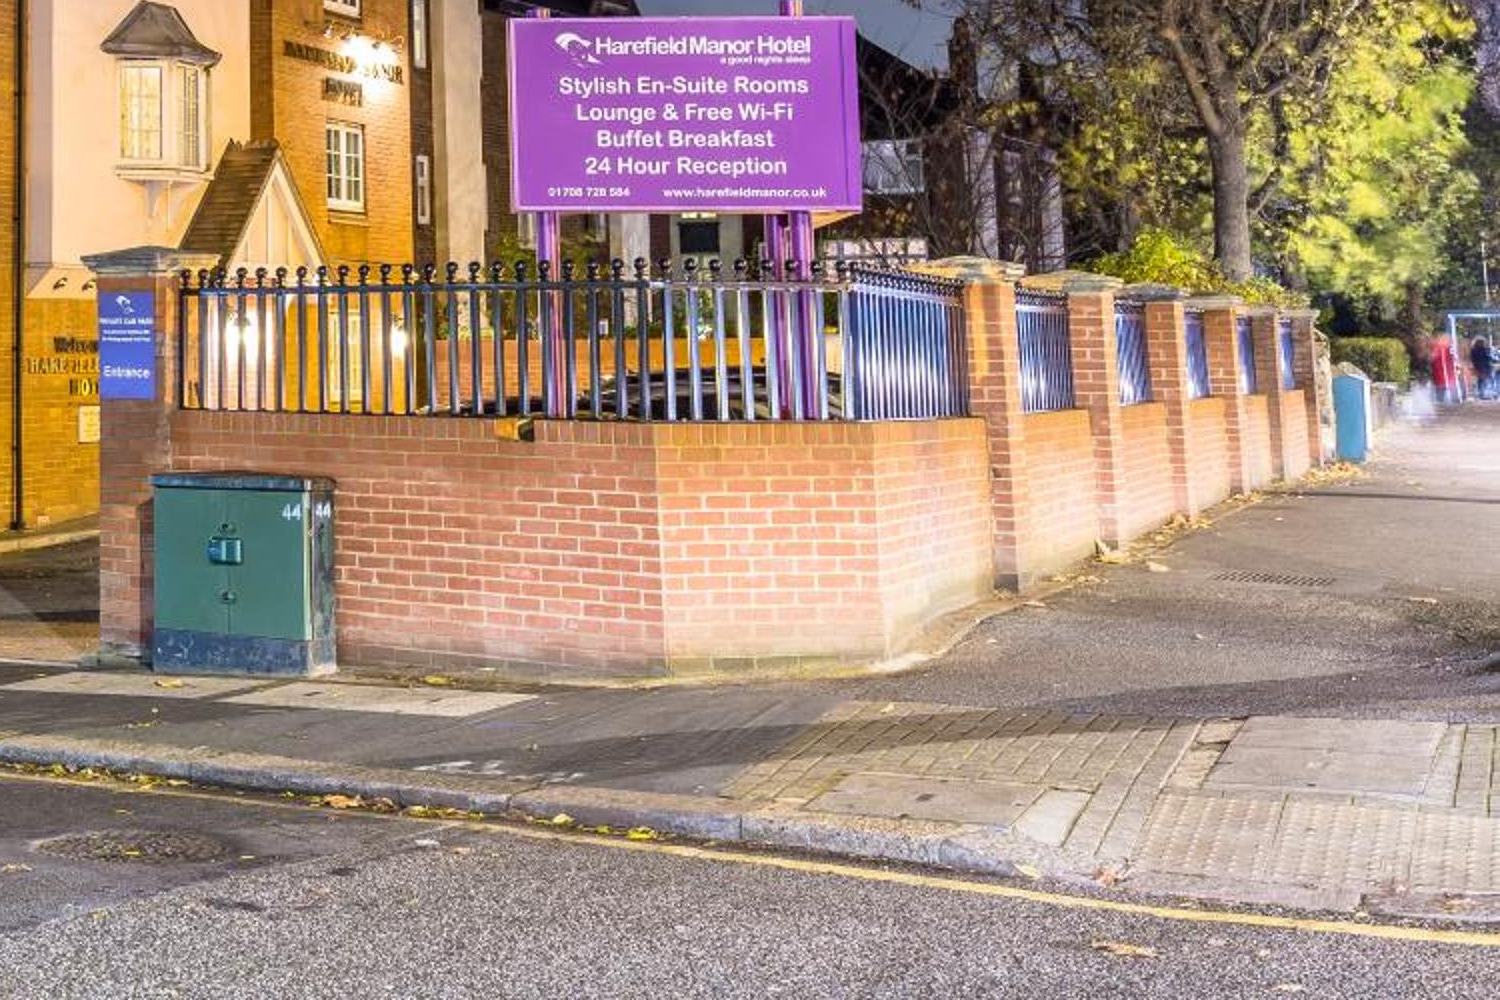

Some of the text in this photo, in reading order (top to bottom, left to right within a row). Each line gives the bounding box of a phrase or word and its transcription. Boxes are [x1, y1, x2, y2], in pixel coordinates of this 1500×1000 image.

[595, 35, 811, 55] Harefield Manor Hotel
[728, 55, 753, 66] good
[559, 75, 809, 99] Stylish En-Suite Rooms
[576, 103, 794, 124] Lounge & Free Wi-Fi
[596, 129, 775, 148] Buffet Breakfast
[585, 156, 788, 179] 24 Hour Reception
[102, 365, 151, 379] Entrance
[282, 503, 301, 521] 44
[314, 501, 331, 519] 44
